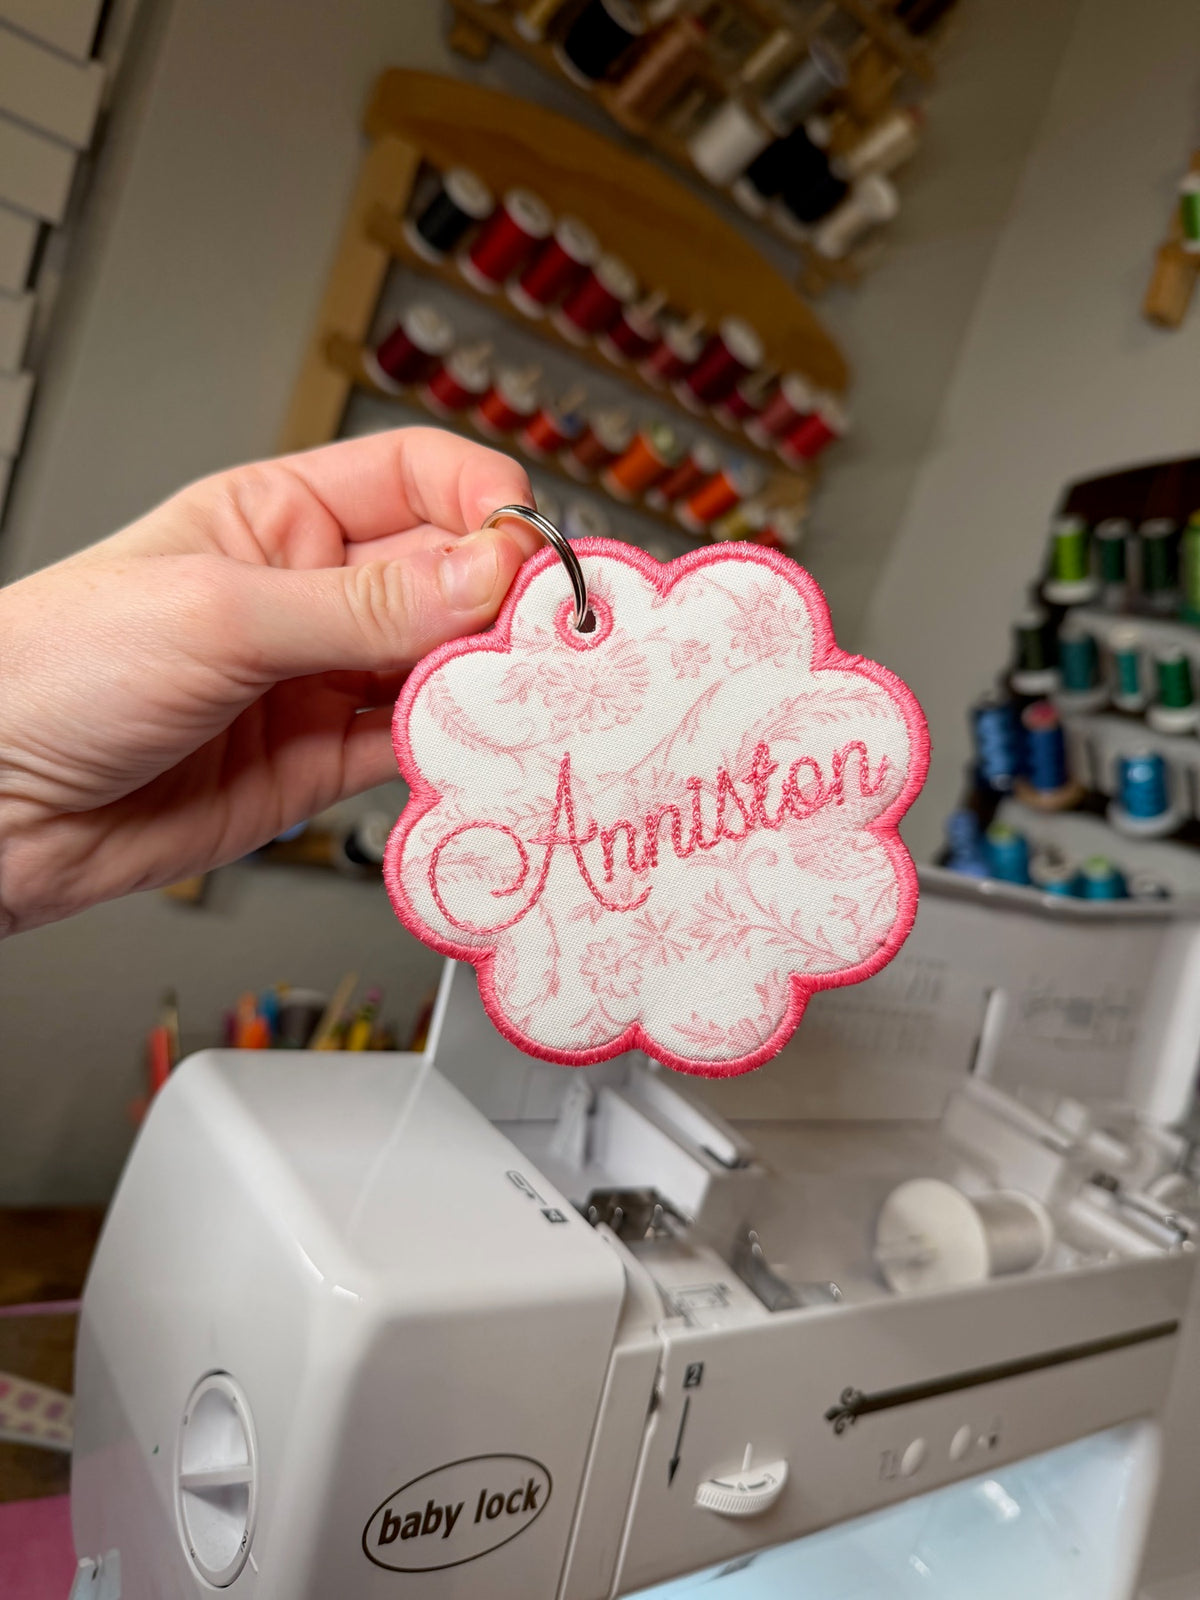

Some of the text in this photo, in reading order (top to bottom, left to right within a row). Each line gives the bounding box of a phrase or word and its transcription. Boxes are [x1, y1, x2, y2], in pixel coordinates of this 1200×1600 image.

[428, 740, 890, 935] Anniston
[377, 1477, 542, 1546] baby lock
